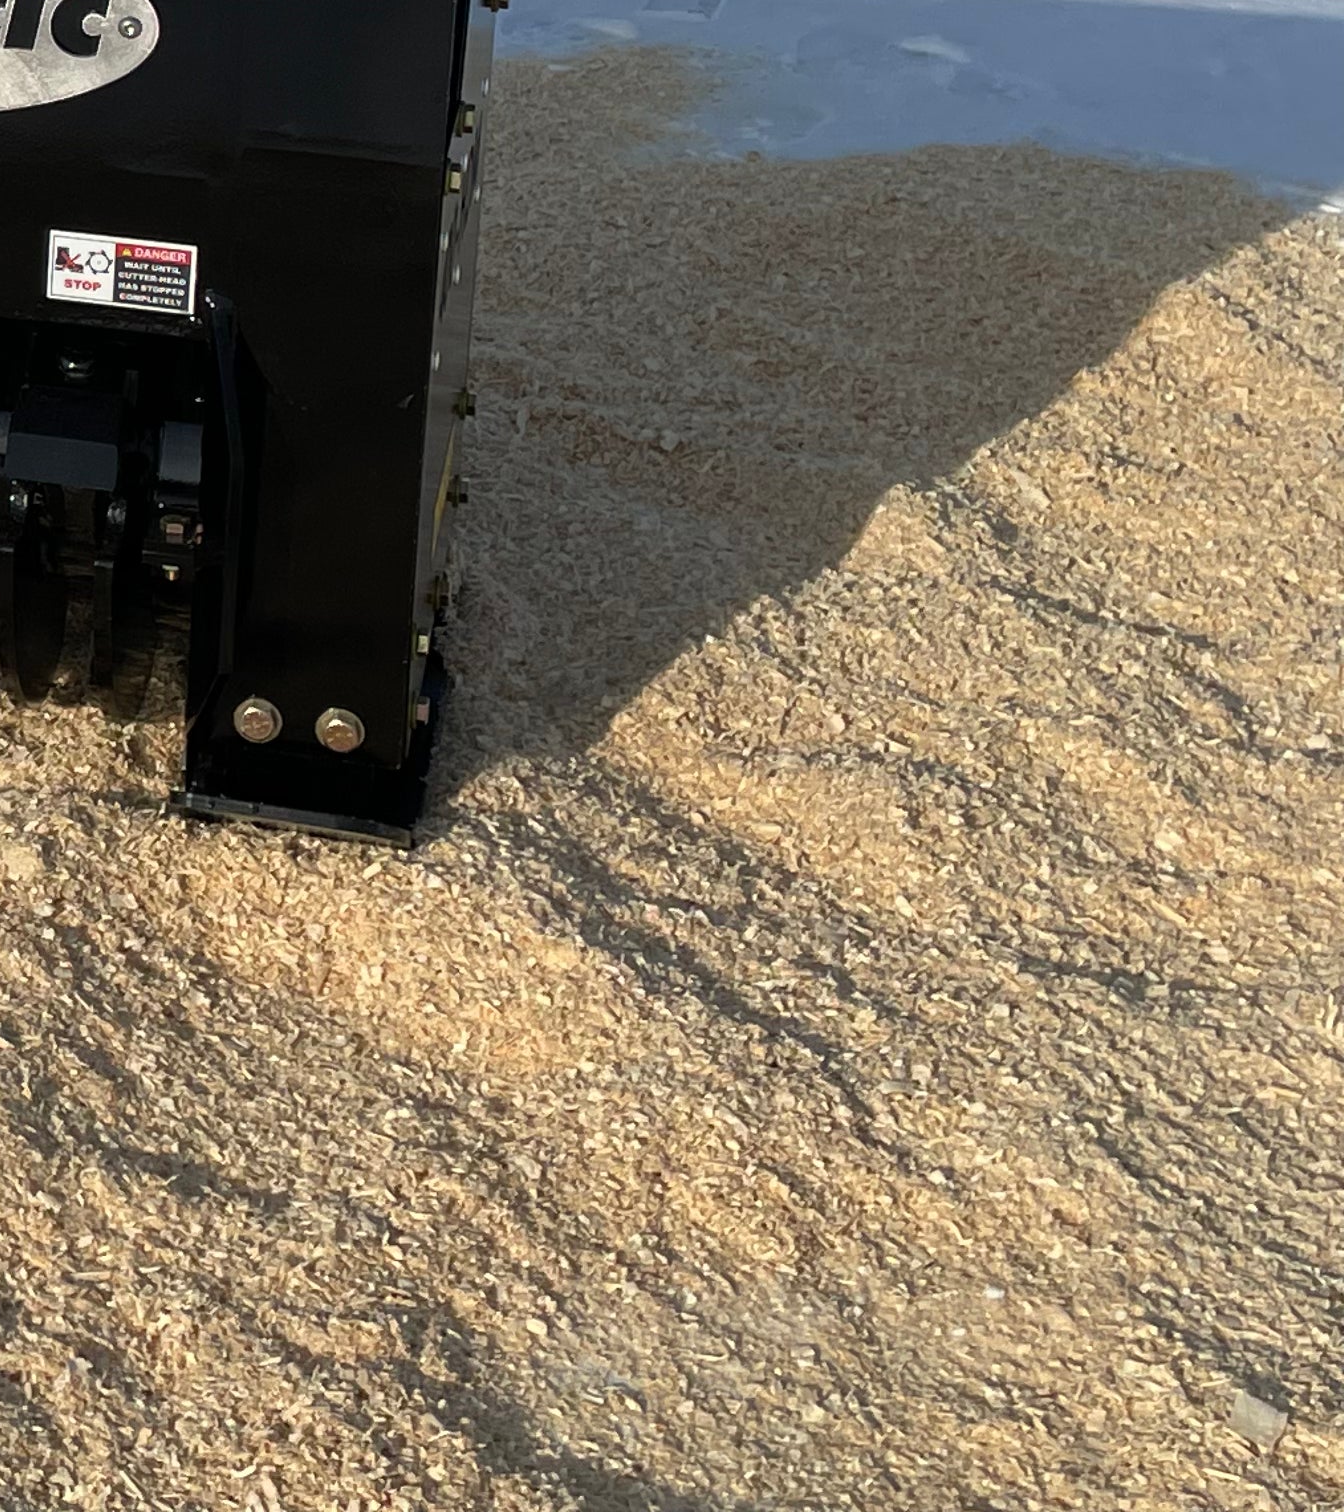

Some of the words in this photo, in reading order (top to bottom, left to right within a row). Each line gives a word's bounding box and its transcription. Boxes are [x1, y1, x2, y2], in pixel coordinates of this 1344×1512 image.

[134, 248, 187, 262] DANGER
[124, 261, 150, 270] WAIT
[151, 264, 181, 275] UNTIL
[64, 279, 102, 291] STOP
[118, 281, 139, 291] HAS
[140, 283, 185, 296] STOPPED
[119, 293, 182, 306] COMPLETELY
